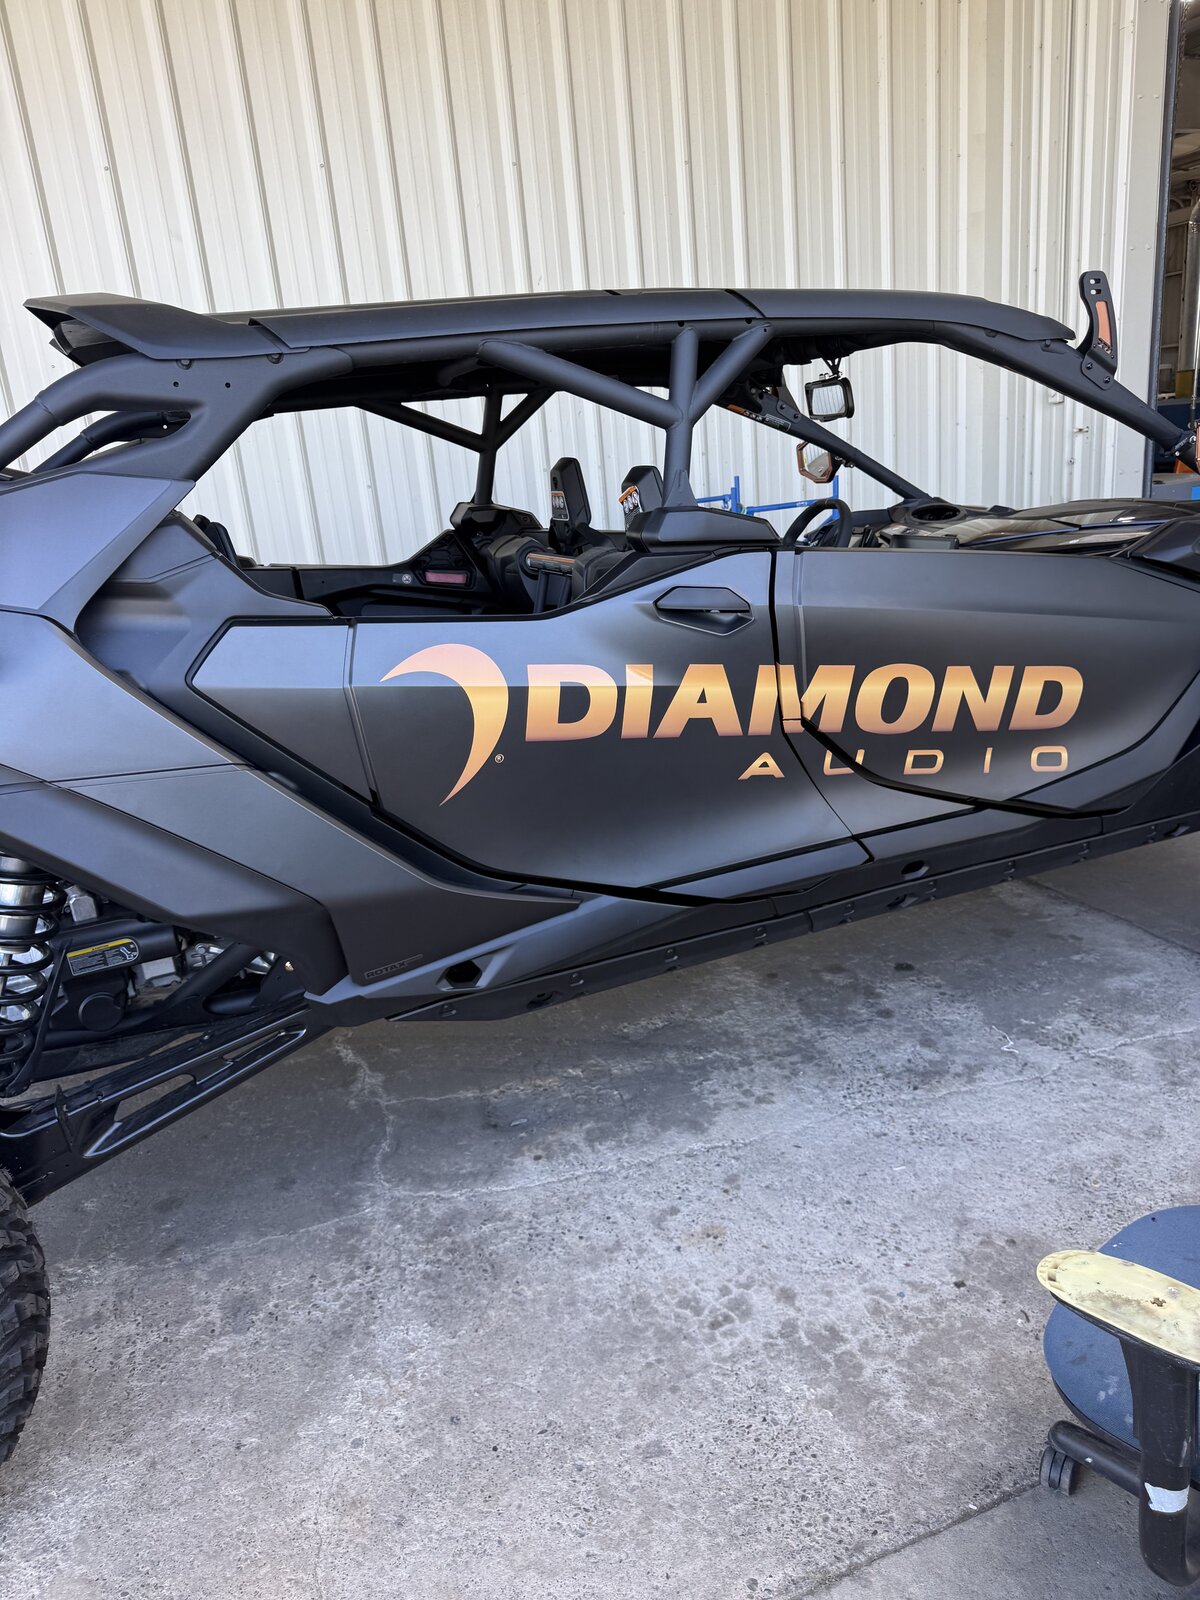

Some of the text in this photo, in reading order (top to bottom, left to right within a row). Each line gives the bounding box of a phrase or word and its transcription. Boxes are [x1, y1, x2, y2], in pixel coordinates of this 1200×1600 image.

[525, 664, 1083, 742] DIAMOND
[739, 746, 1069, 780] AUDIO
[365, 961, 408, 979] ROTAX
